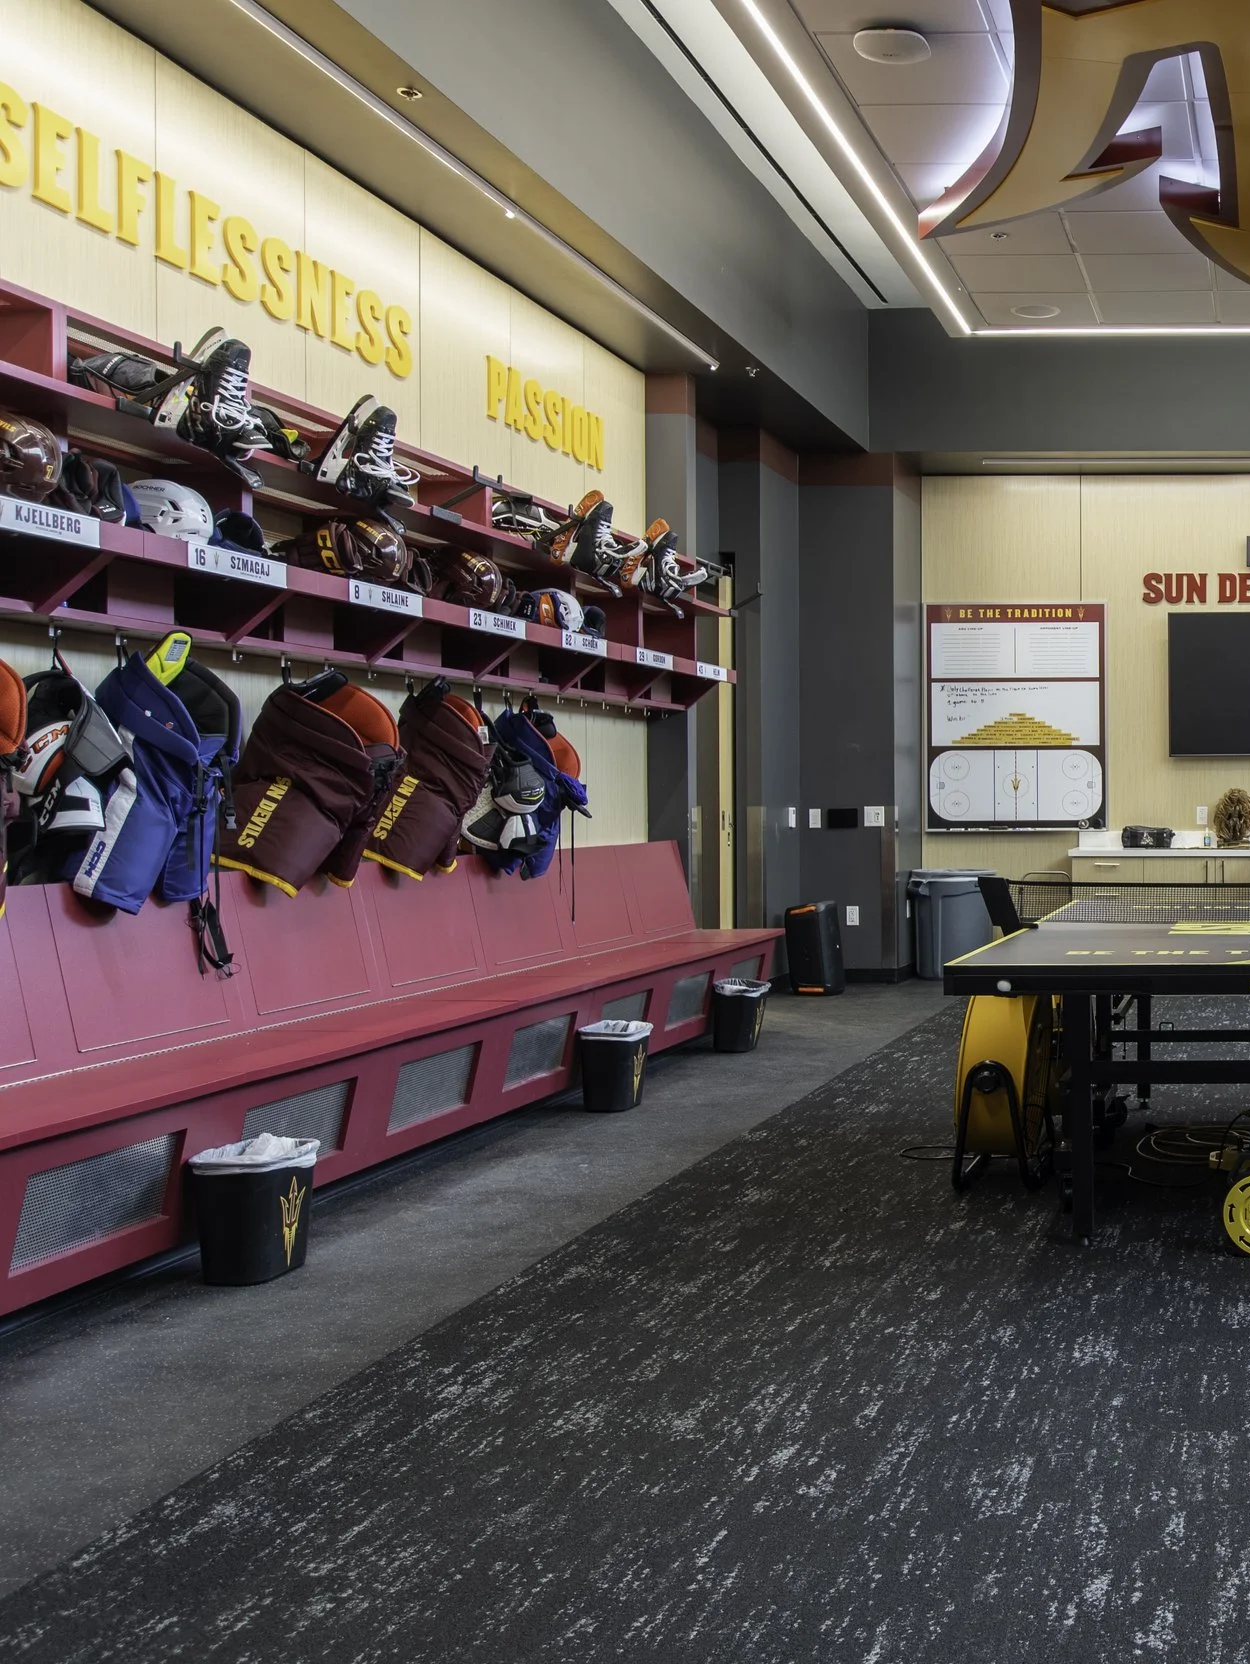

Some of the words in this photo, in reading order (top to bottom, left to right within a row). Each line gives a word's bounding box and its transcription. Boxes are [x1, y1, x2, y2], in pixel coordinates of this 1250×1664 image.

[485, 354, 605, 472] PASSION
[15, 504, 81, 535] KJELLBERG
[195, 547, 207, 567] 16
[230, 555, 271, 577] SZMAGAJ
[354, 584, 360, 600] 8
[381, 590, 409, 608] SHLAINE
[1142, 572, 1209, 604] SUN
[473, 612, 482, 626] 23
[493, 616, 517, 632] SCHIMEK
[959, 608, 973, 618] BE
[979, 608, 1001, 618] THE
[1007, 608, 1073, 618] TRADITION
[39, 778, 62, 826] CCM
[238, 797, 278, 849] DEVILS
[373, 796, 411, 841] DEVILS
[85, 840, 106, 878] CCM
